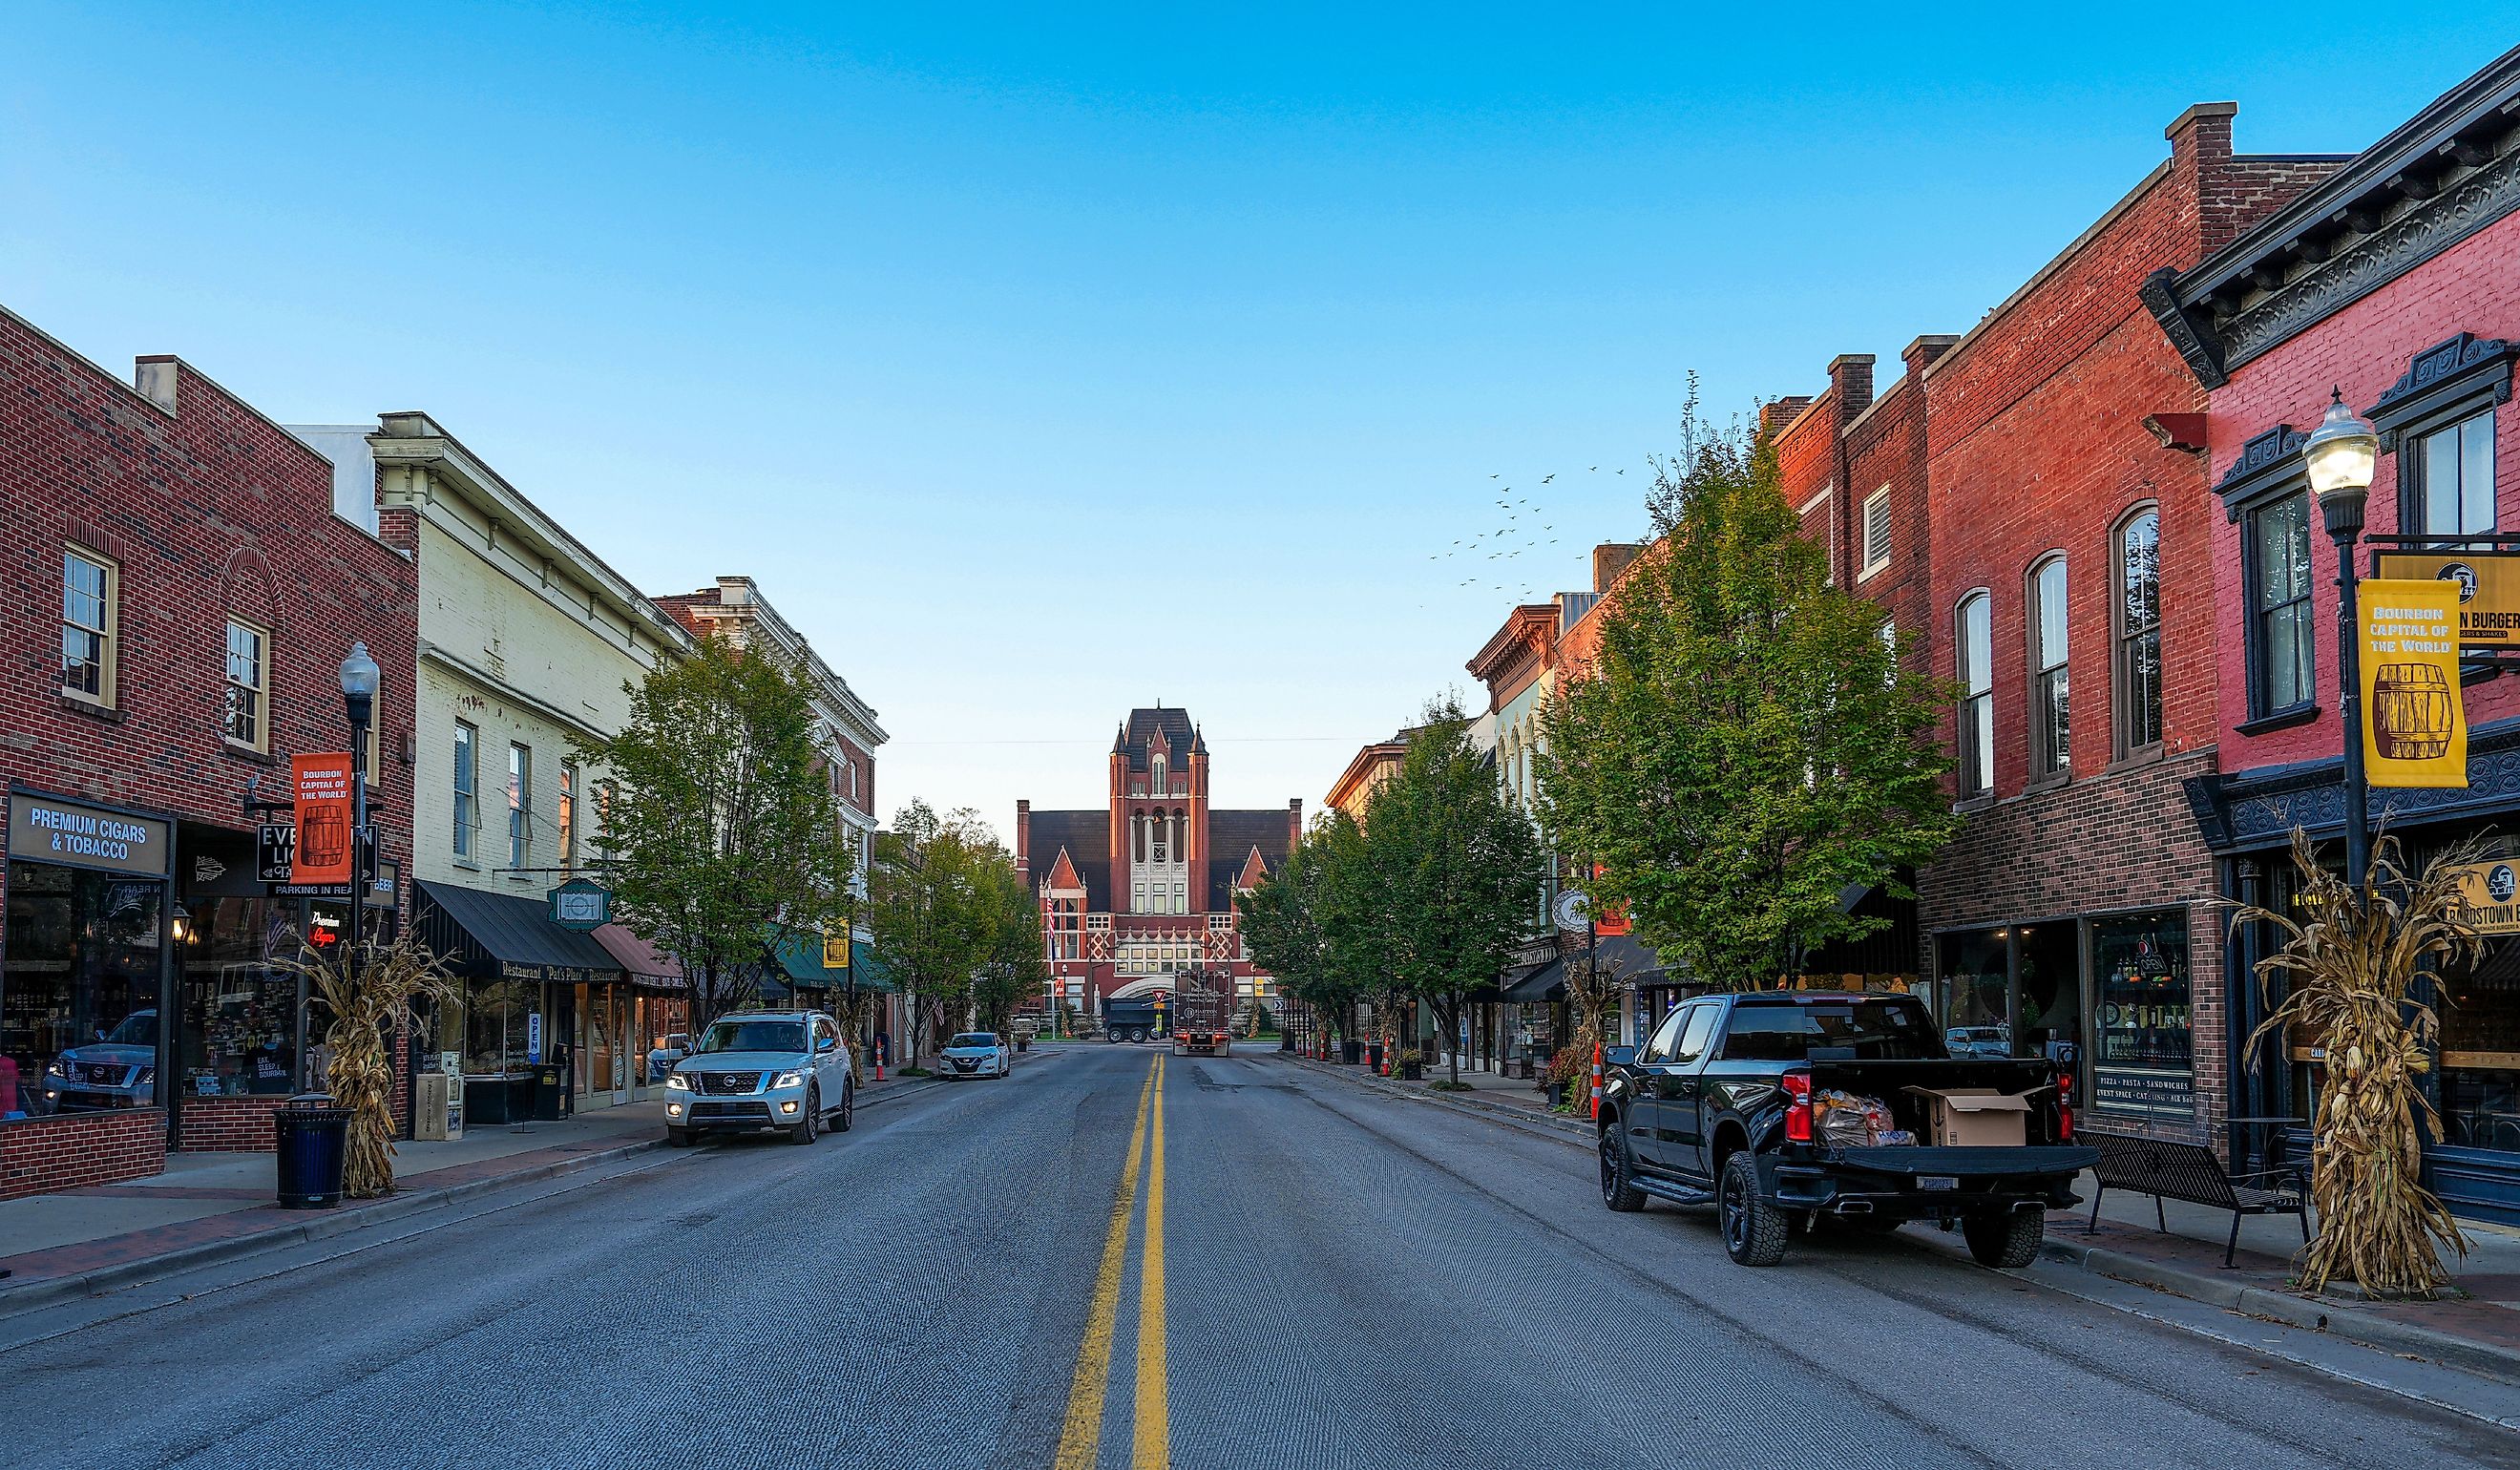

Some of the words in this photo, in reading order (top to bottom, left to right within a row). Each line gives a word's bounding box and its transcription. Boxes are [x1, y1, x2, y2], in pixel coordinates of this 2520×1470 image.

[2373, 607, 2444, 620] BOURBON
[2370, 623, 2427, 637] CAPITAL
[2431, 625, 2448, 637] OF
[2371, 640, 2396, 652] THE
[2401, 640, 2450, 653] WORLD
[303, 770, 342, 779] BOURBON
[301, 781, 333, 789] CAPITAL
[318, 790, 346, 799] WORLD
[31, 807, 96, 835] PREMIUM
[99, 819, 146, 844] CIGARS
[52, 831, 62, 850] &
[65, 833, 128, 860] TOBACCO
[275, 885, 318, 894] PARKING
[334, 886, 352, 894] REA
[2449, 904, 2513, 925] BADSTOWN
[2140, 958, 2164, 970] OPEN
[502, 961, 541, 979] Restaurant
[589, 968, 620, 981] Restaurant
[2100, 1077, 2117, 1085] PIZZA
[2122, 1079, 2141, 1087] PASTA
[2147, 1080, 2189, 1090] SANDWICHES
[2115, 1090, 2132, 1099] SPACE
